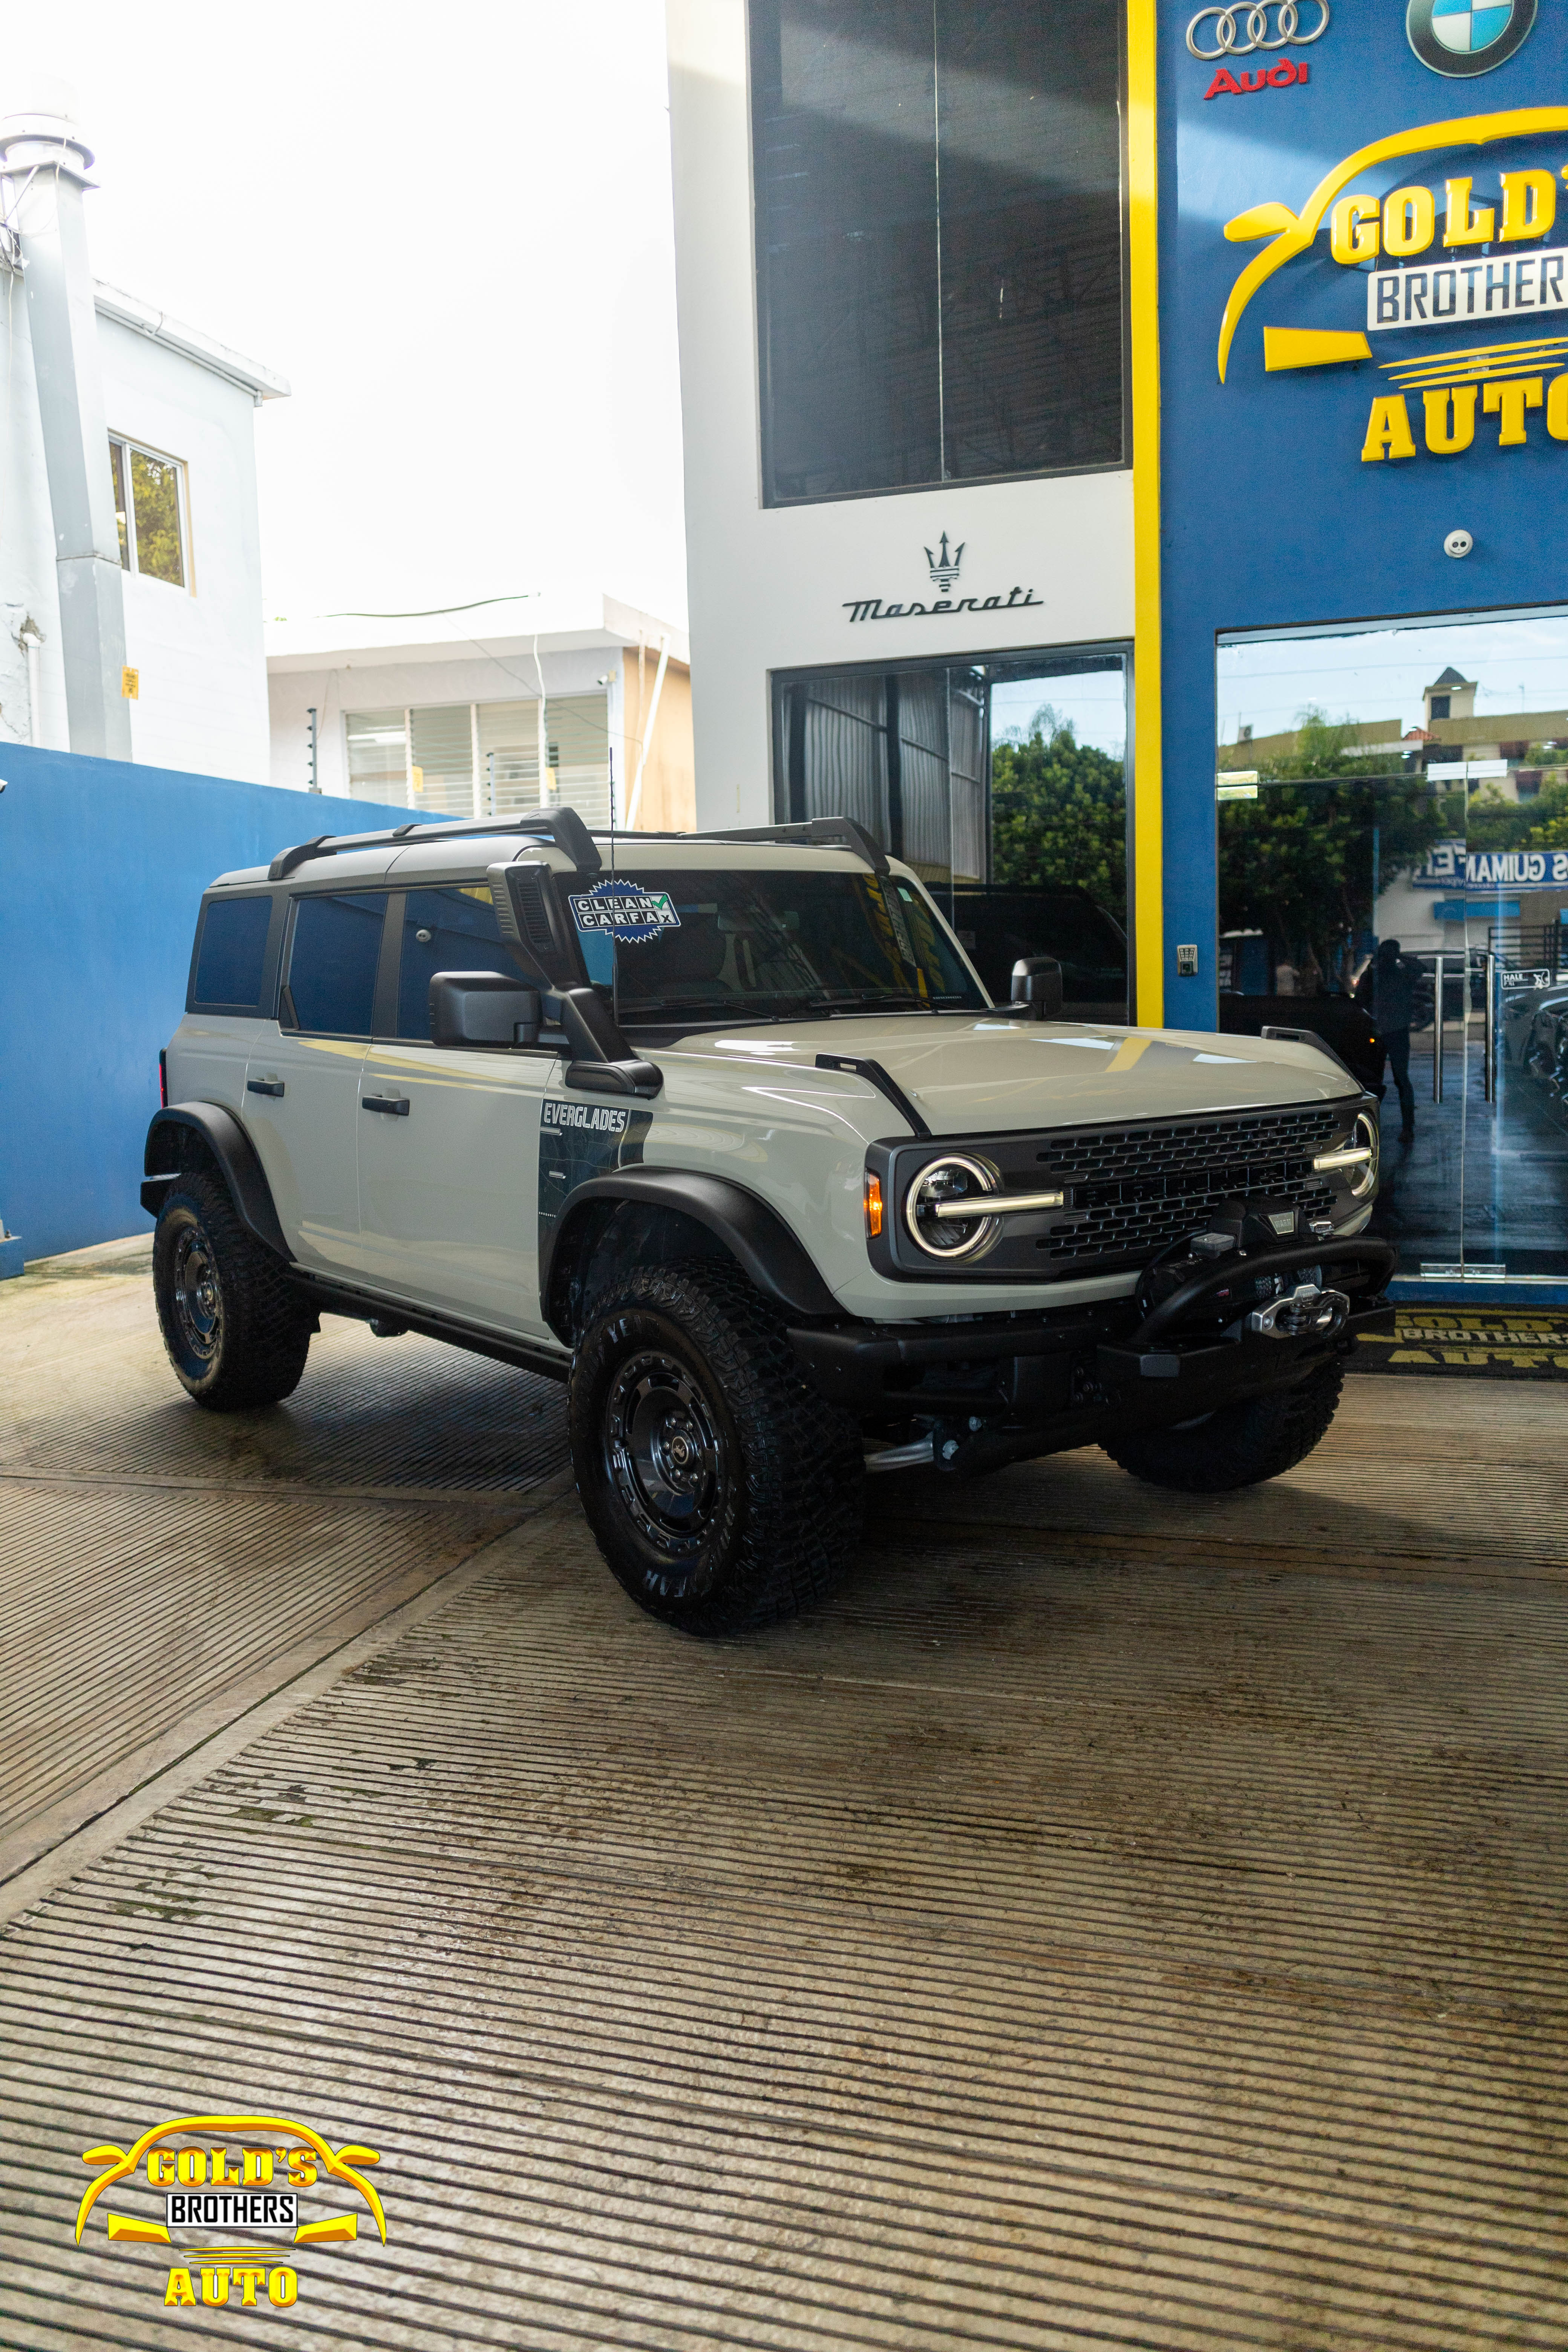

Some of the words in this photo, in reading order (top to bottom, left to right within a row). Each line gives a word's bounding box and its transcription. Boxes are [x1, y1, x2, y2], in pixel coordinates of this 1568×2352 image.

[1204, 58, 1308, 100] Audi
[842, 586, 1044, 622] Maserati
[578, 898, 653, 911] CLEAN
[582, 912, 672, 925] CARFAX
[544, 1102, 626, 1133] EVERGLADES
